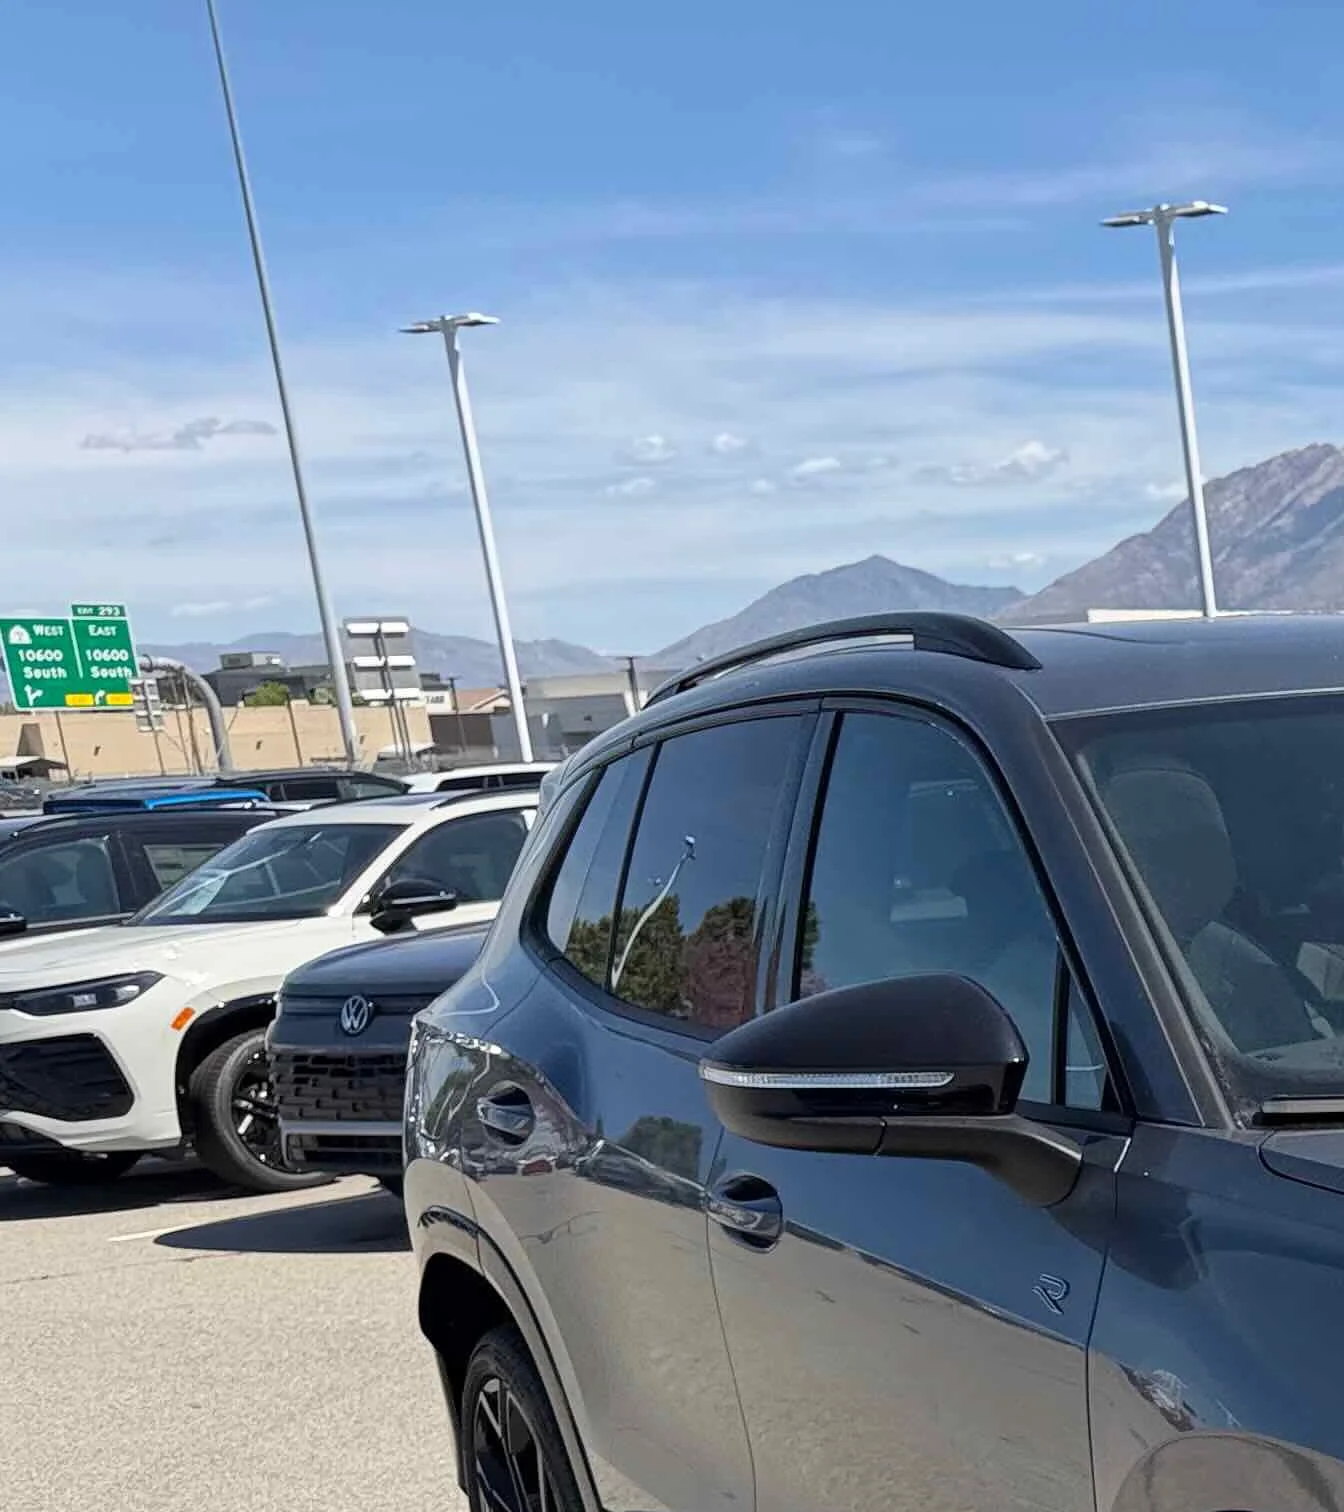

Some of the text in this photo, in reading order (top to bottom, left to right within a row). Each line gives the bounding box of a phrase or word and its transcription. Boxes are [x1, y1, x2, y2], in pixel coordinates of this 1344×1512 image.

[98, 606, 121, 616] 293
[32, 624, 64, 637] WEST
[88, 624, 117, 637] EAST
[18, 649, 64, 662] 10600
[85, 649, 129, 662] 10600
[23, 665, 68, 679] South
[90, 665, 133, 679] South
